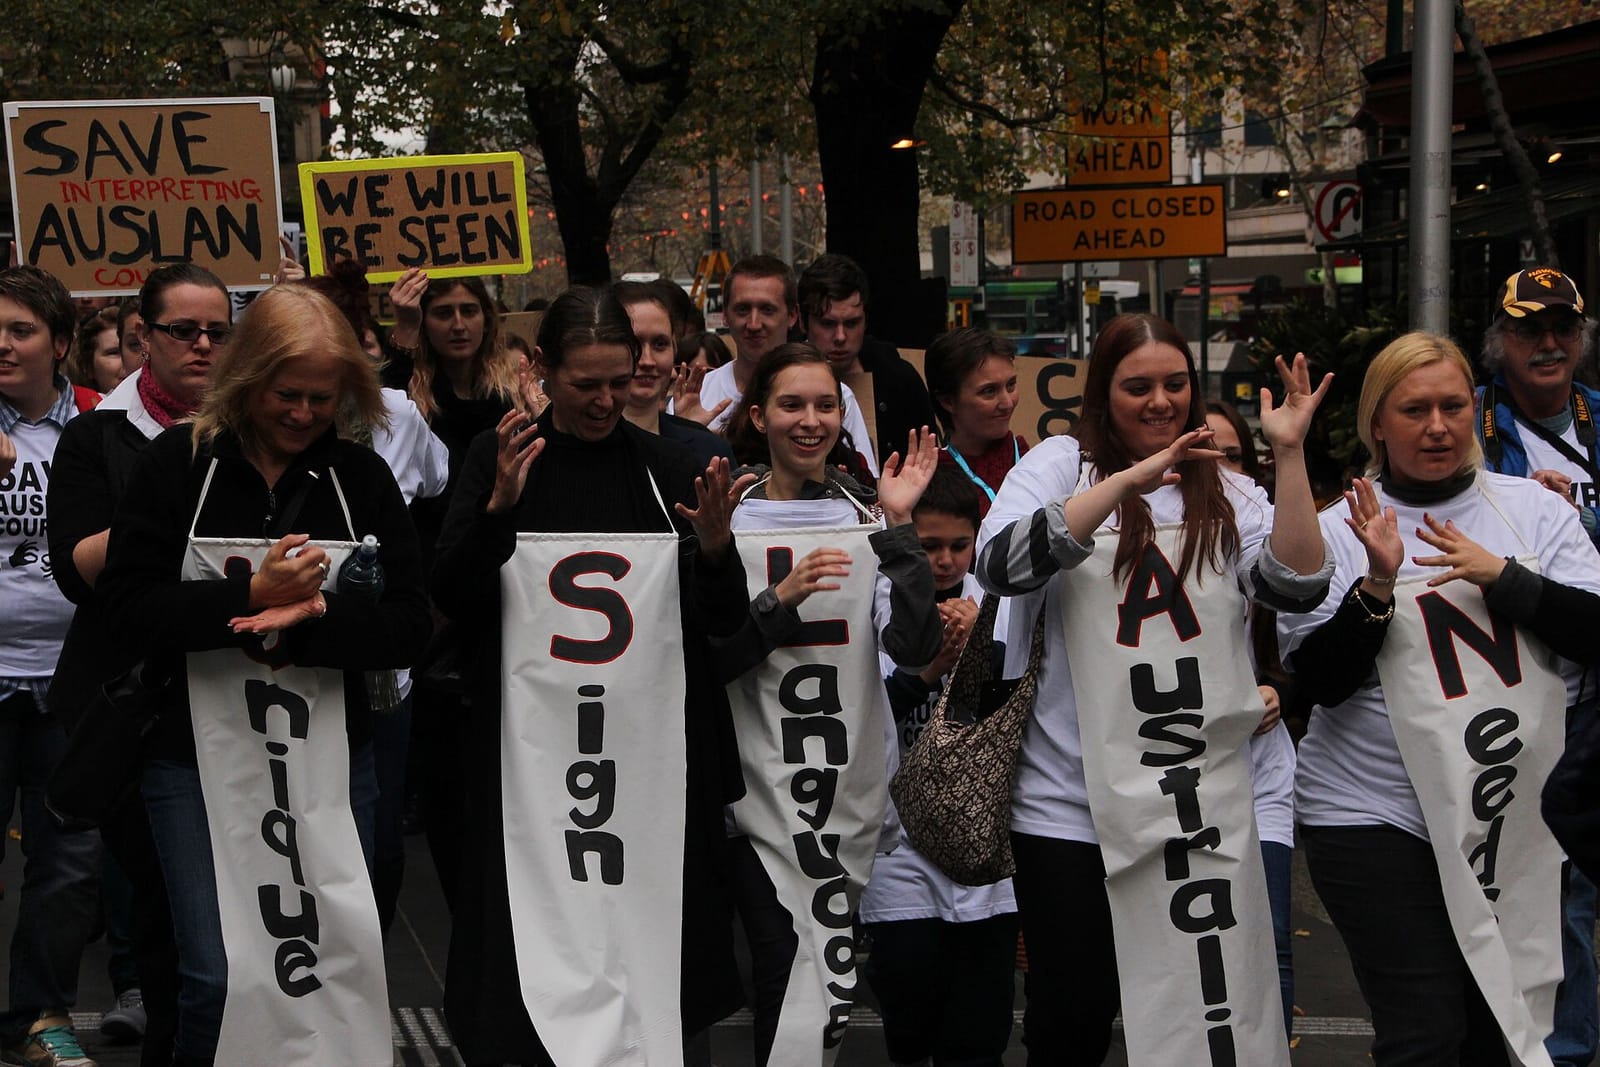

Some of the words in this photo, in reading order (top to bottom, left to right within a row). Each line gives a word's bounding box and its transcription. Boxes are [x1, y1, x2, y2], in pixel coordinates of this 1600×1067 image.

[23, 111, 228, 180] SAVE
[1075, 142, 1163, 172] AHEAD
[59, 177, 264, 203] INTERPRETING
[317, 175, 394, 217] WE
[405, 169, 511, 211] WILL
[1023, 201, 1096, 222] ROAD
[1112, 196, 1215, 220] CLOSED
[28, 203, 262, 266] AUSLAN
[323, 223, 384, 266] BE
[396, 210, 520, 267] SEEN
[1072, 227, 1166, 250] AHEAD
[548, 551, 634, 885] Sign
[1415, 584, 1525, 924] Need
